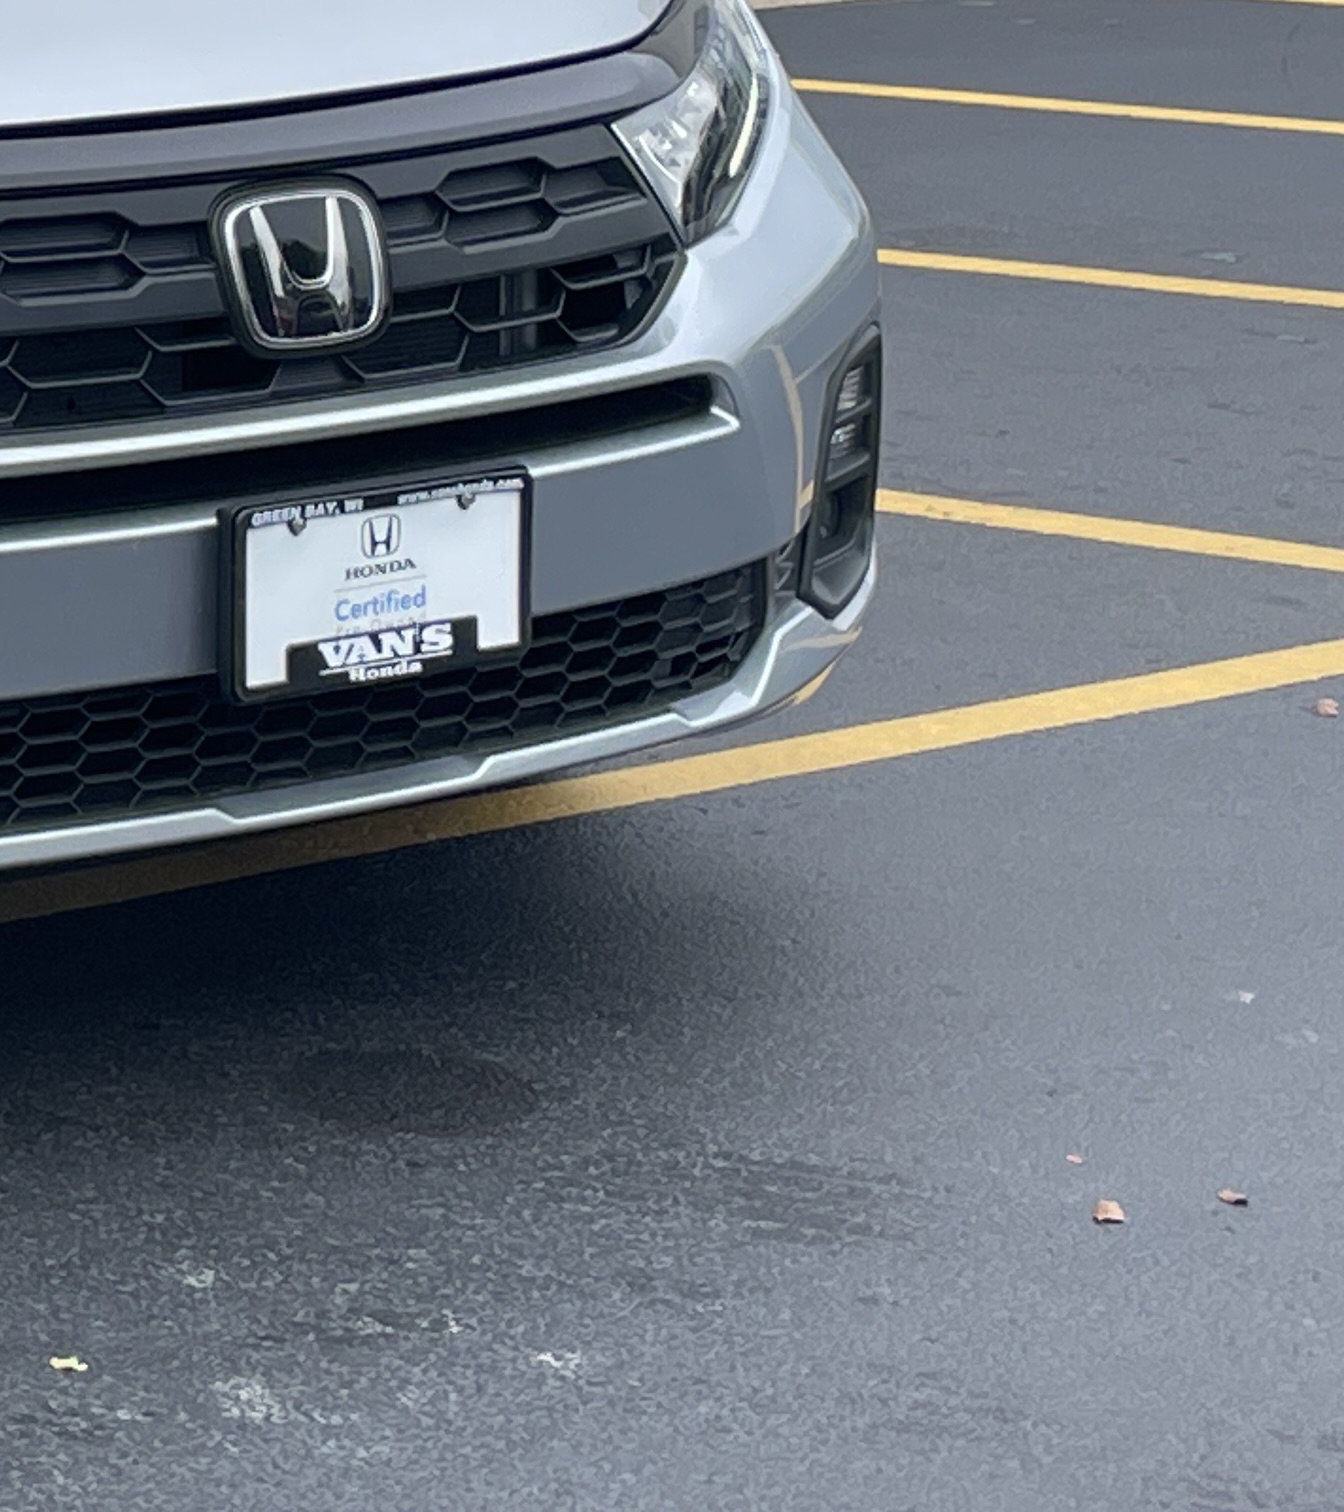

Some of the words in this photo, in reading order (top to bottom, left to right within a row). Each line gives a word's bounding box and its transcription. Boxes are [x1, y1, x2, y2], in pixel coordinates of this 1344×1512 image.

[252, 505, 302, 527] GREEN
[345, 557, 417, 581] HONDA
[334, 584, 427, 622] Certified
[317, 622, 454, 669] VAN'S
[349, 658, 424, 683] Honda
